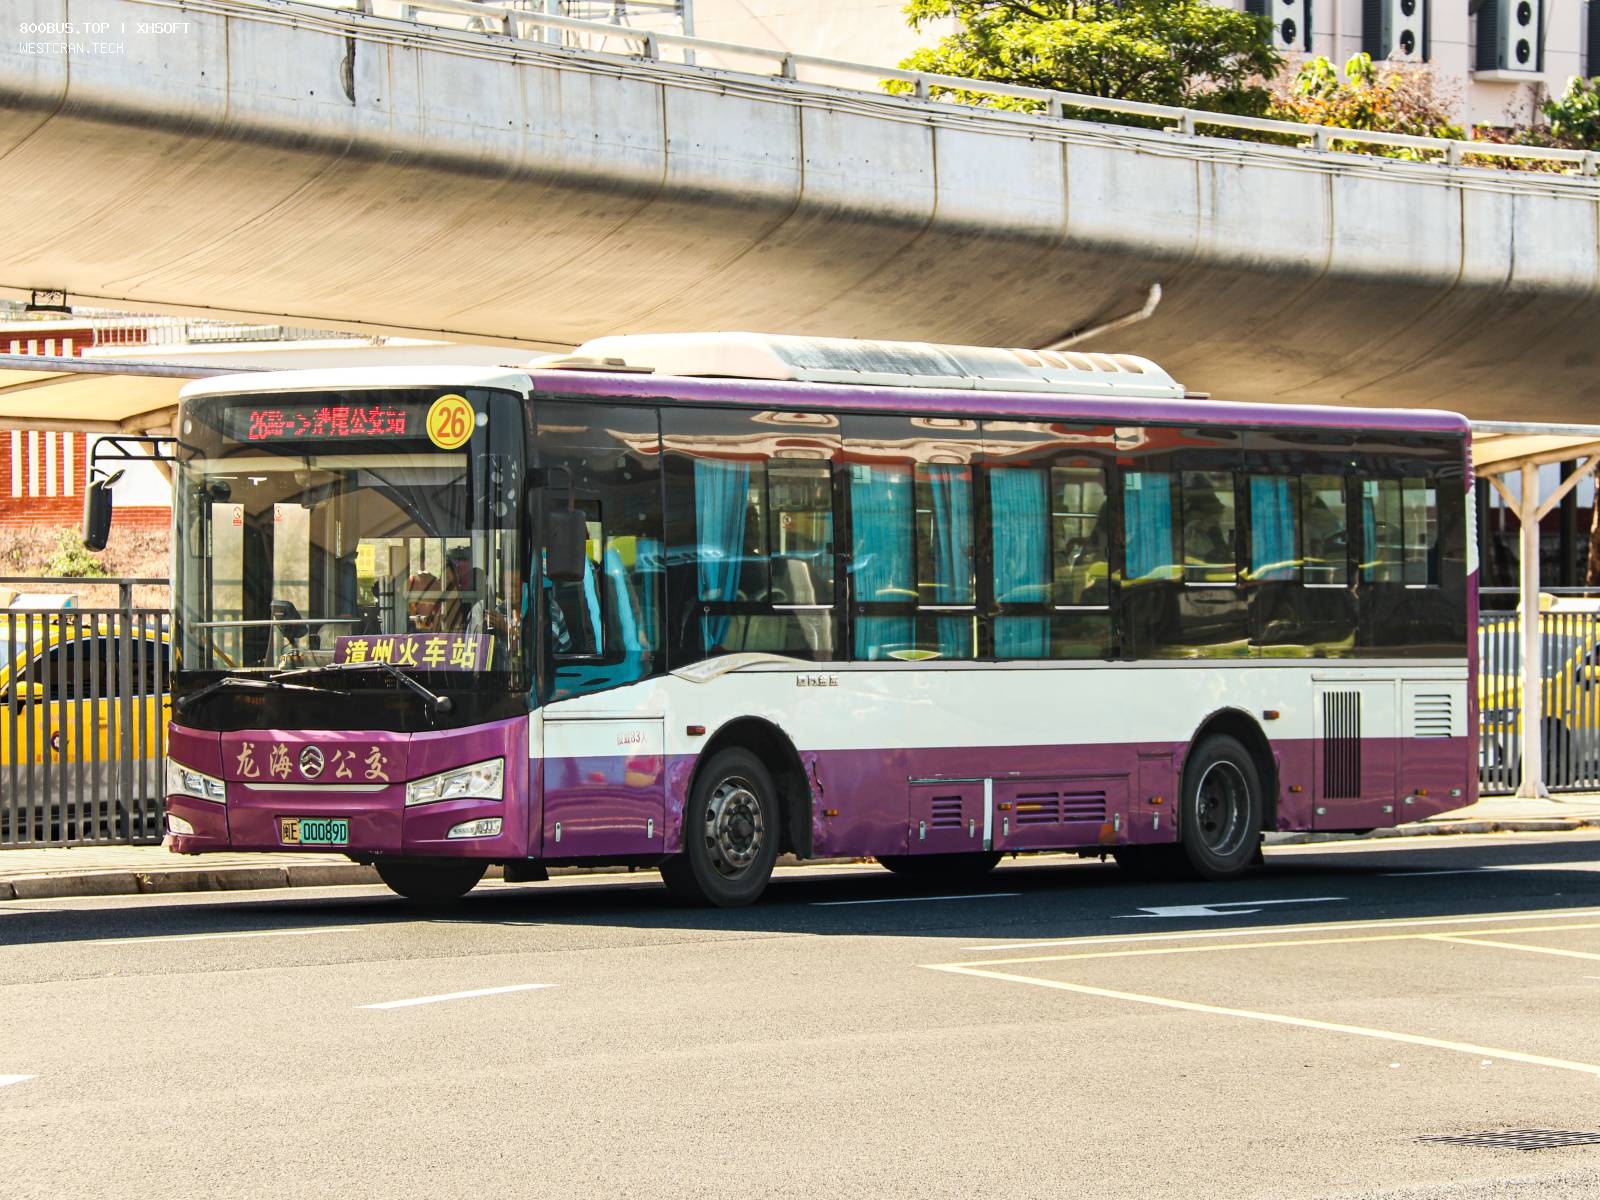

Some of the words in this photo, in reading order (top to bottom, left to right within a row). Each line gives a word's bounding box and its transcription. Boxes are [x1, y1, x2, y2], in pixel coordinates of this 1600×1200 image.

[436, 406, 466, 438] 26
[344, 636, 478, 669] 漳州火车站
[235, 742, 390, 782] 龙海公交
